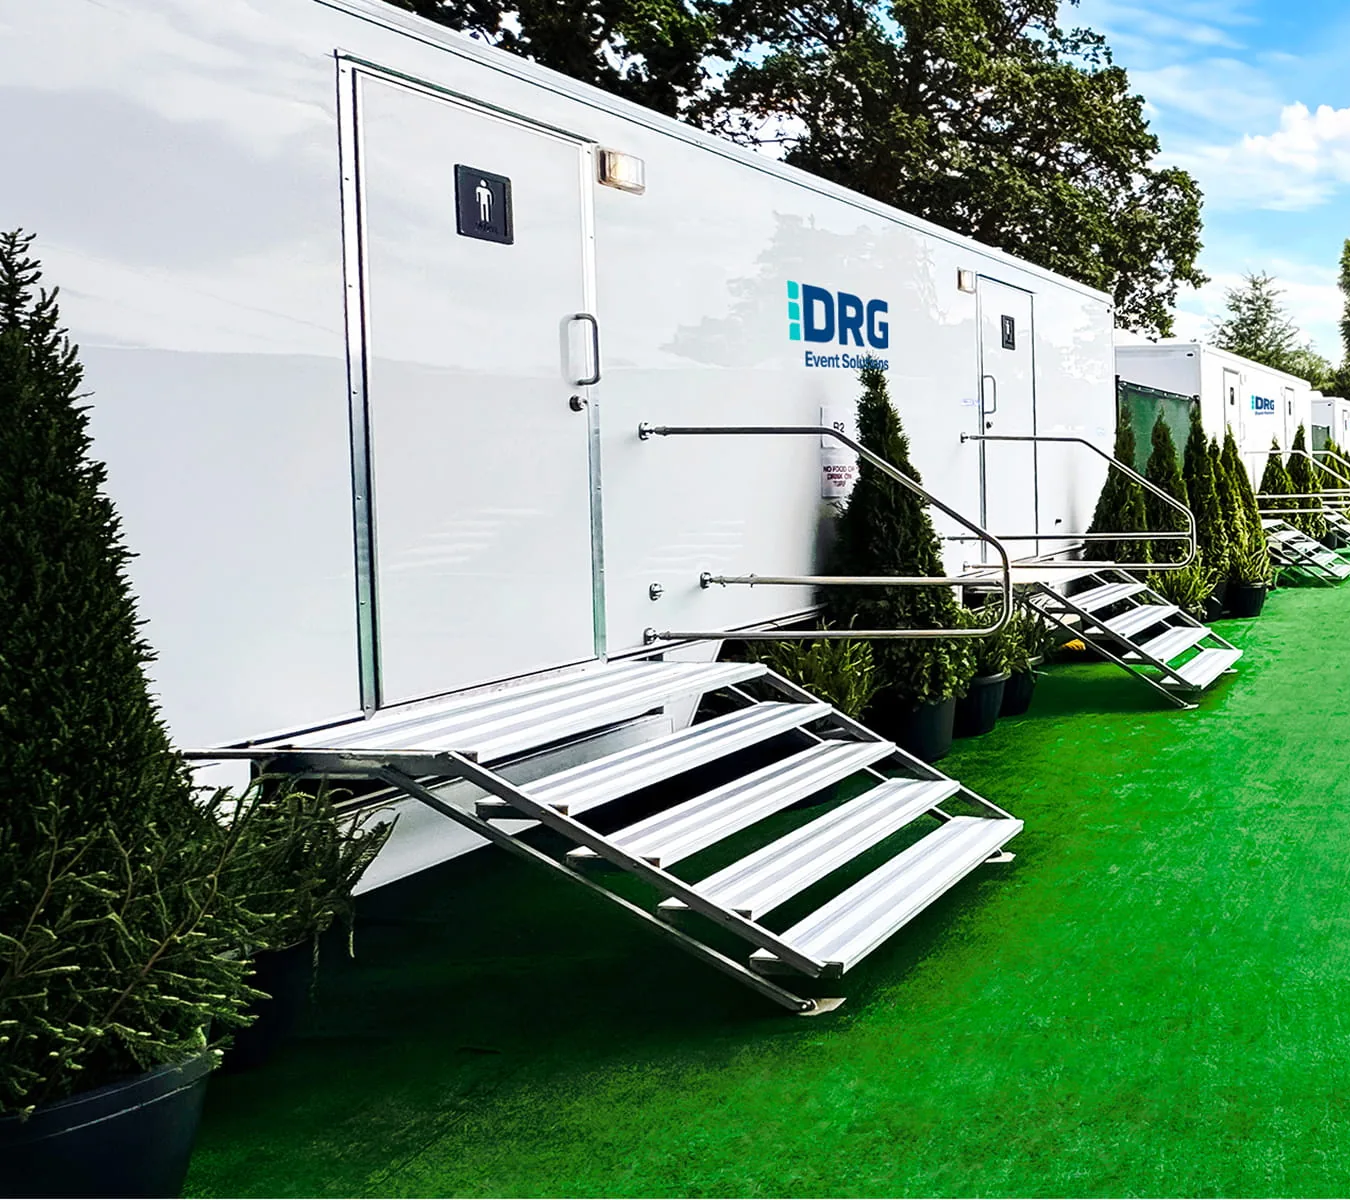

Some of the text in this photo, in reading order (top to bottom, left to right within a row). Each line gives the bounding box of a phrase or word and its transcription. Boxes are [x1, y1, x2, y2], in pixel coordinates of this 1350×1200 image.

[802, 283, 889, 350] DRG
[805, 350, 840, 368] Event
[1255, 395, 1275, 411] DRG
